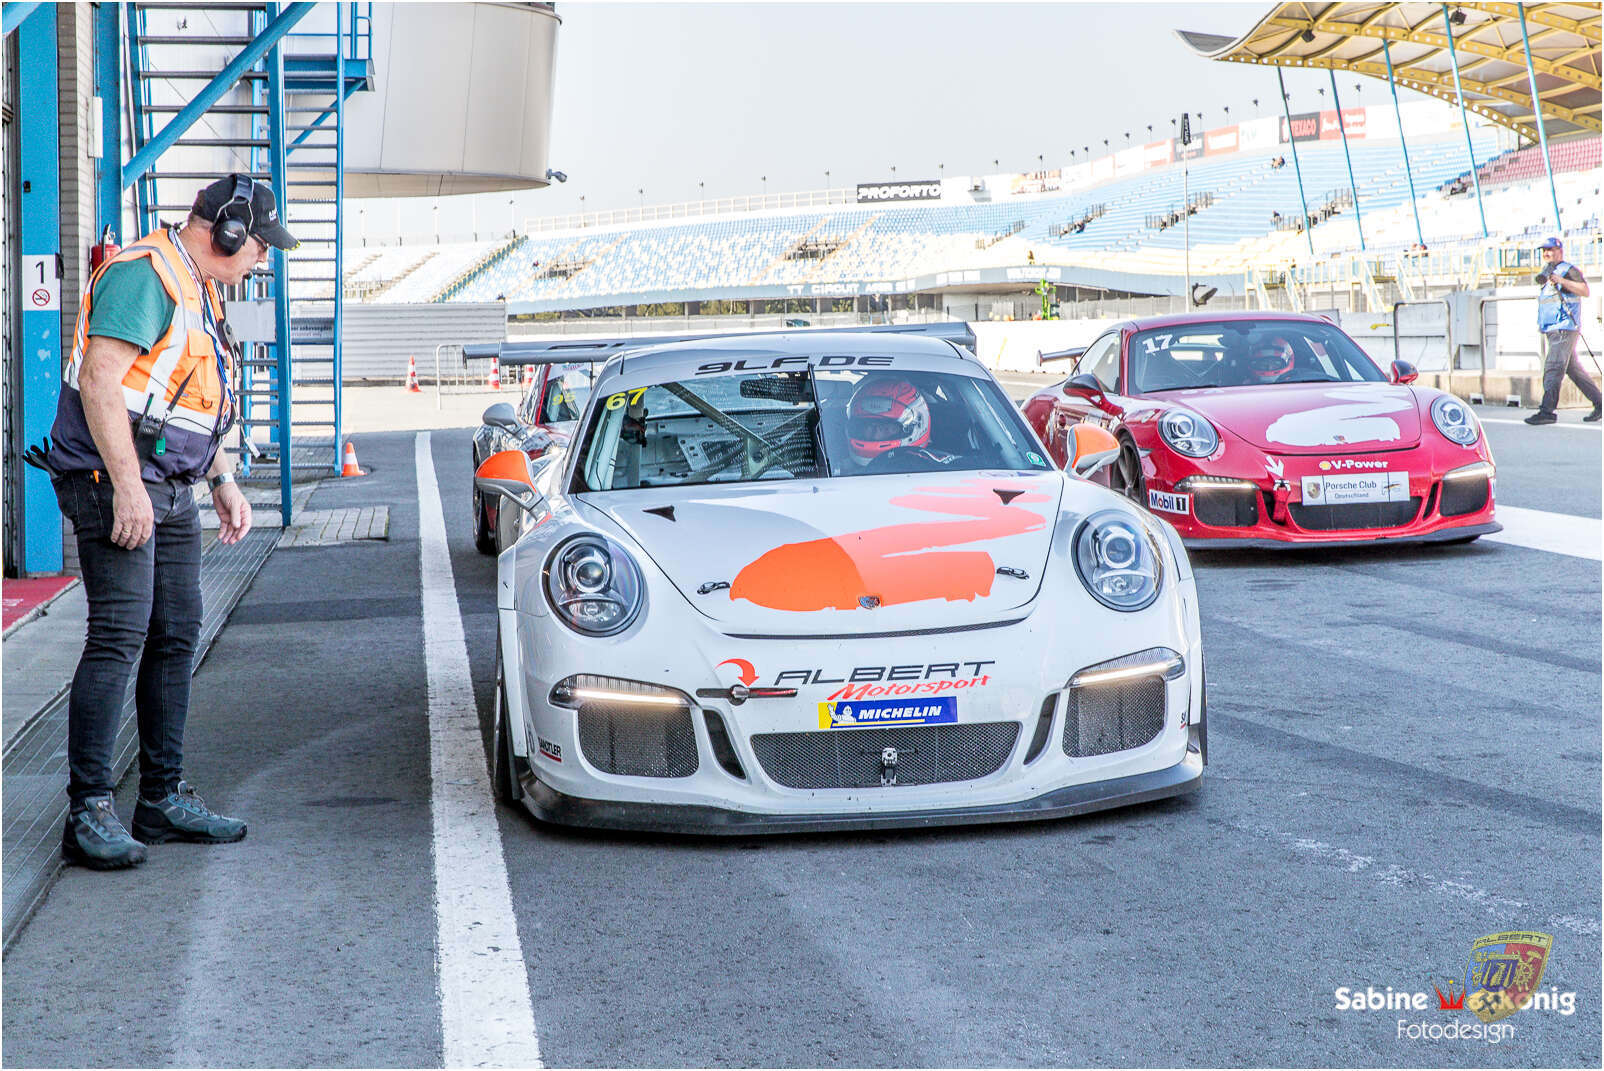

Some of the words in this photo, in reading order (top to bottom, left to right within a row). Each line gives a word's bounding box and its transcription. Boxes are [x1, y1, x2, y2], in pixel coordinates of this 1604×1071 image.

[857, 184, 941, 200] PROFORTO
[35, 260, 45, 284] 1
[787, 285, 804, 295] TT
[811, 283, 860, 295] CIRCUIT
[1142, 334, 1173, 354] 17
[606, 387, 648, 411] 67
[1331, 460, 1389, 470] V-Power
[1325, 481, 1358, 490] Porsche
[1359, 480, 1377, 489] Club
[1151, 492, 1175, 510] Mobil
[774, 660, 996, 686] ALBERT
[827, 674, 992, 701] Motorsport
[858, 704, 943, 720] MICHELIN
